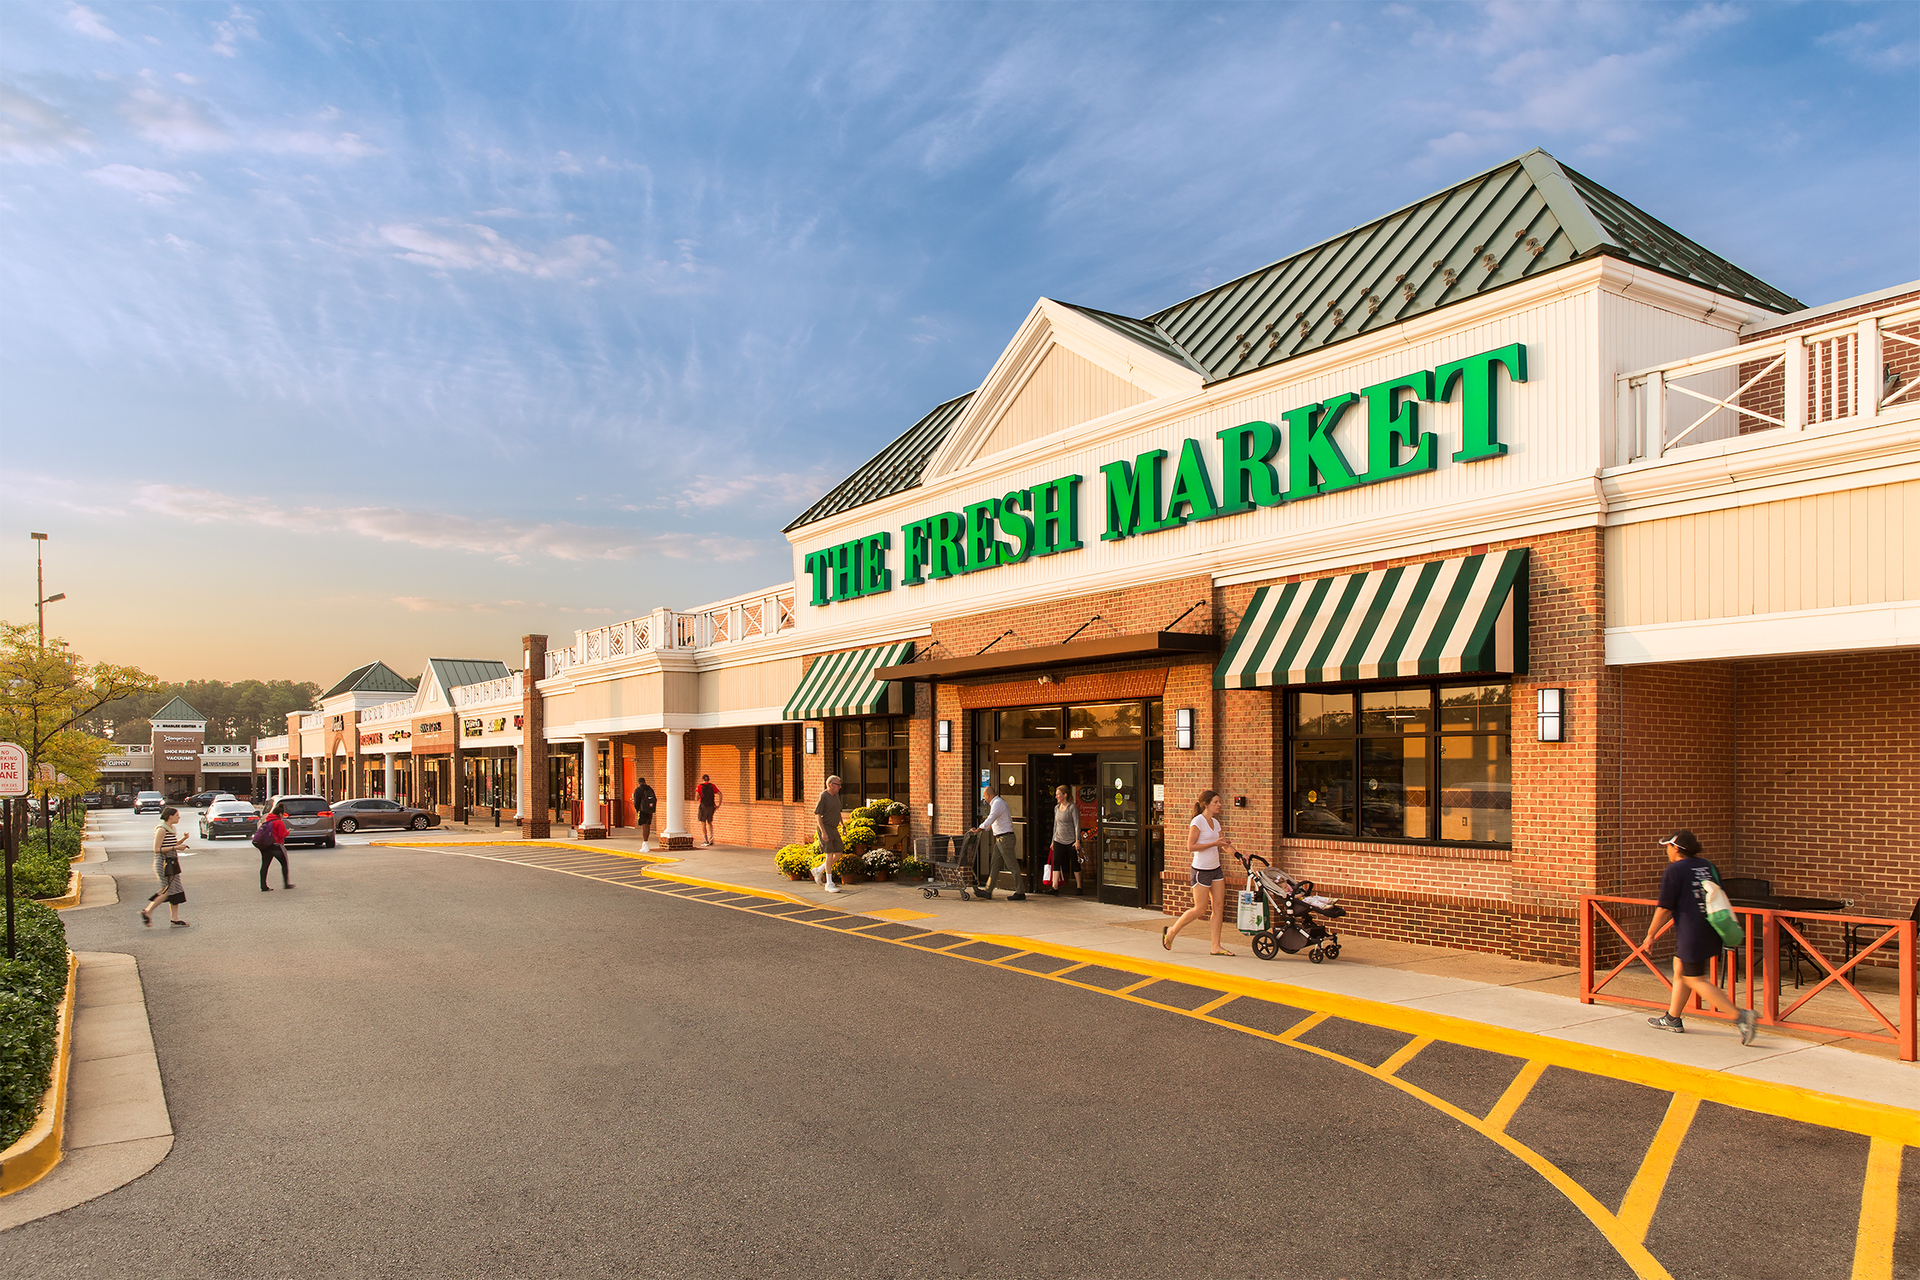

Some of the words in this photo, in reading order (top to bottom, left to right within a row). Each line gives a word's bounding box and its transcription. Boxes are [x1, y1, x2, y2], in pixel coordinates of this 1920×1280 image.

[805, 531, 892, 606] THE
[901, 474, 1084, 586] FRESH
[1100, 343, 1527, 541] MARKET
[0, 762, 16, 770] IRE
[0, 771, 18, 779] ANE
